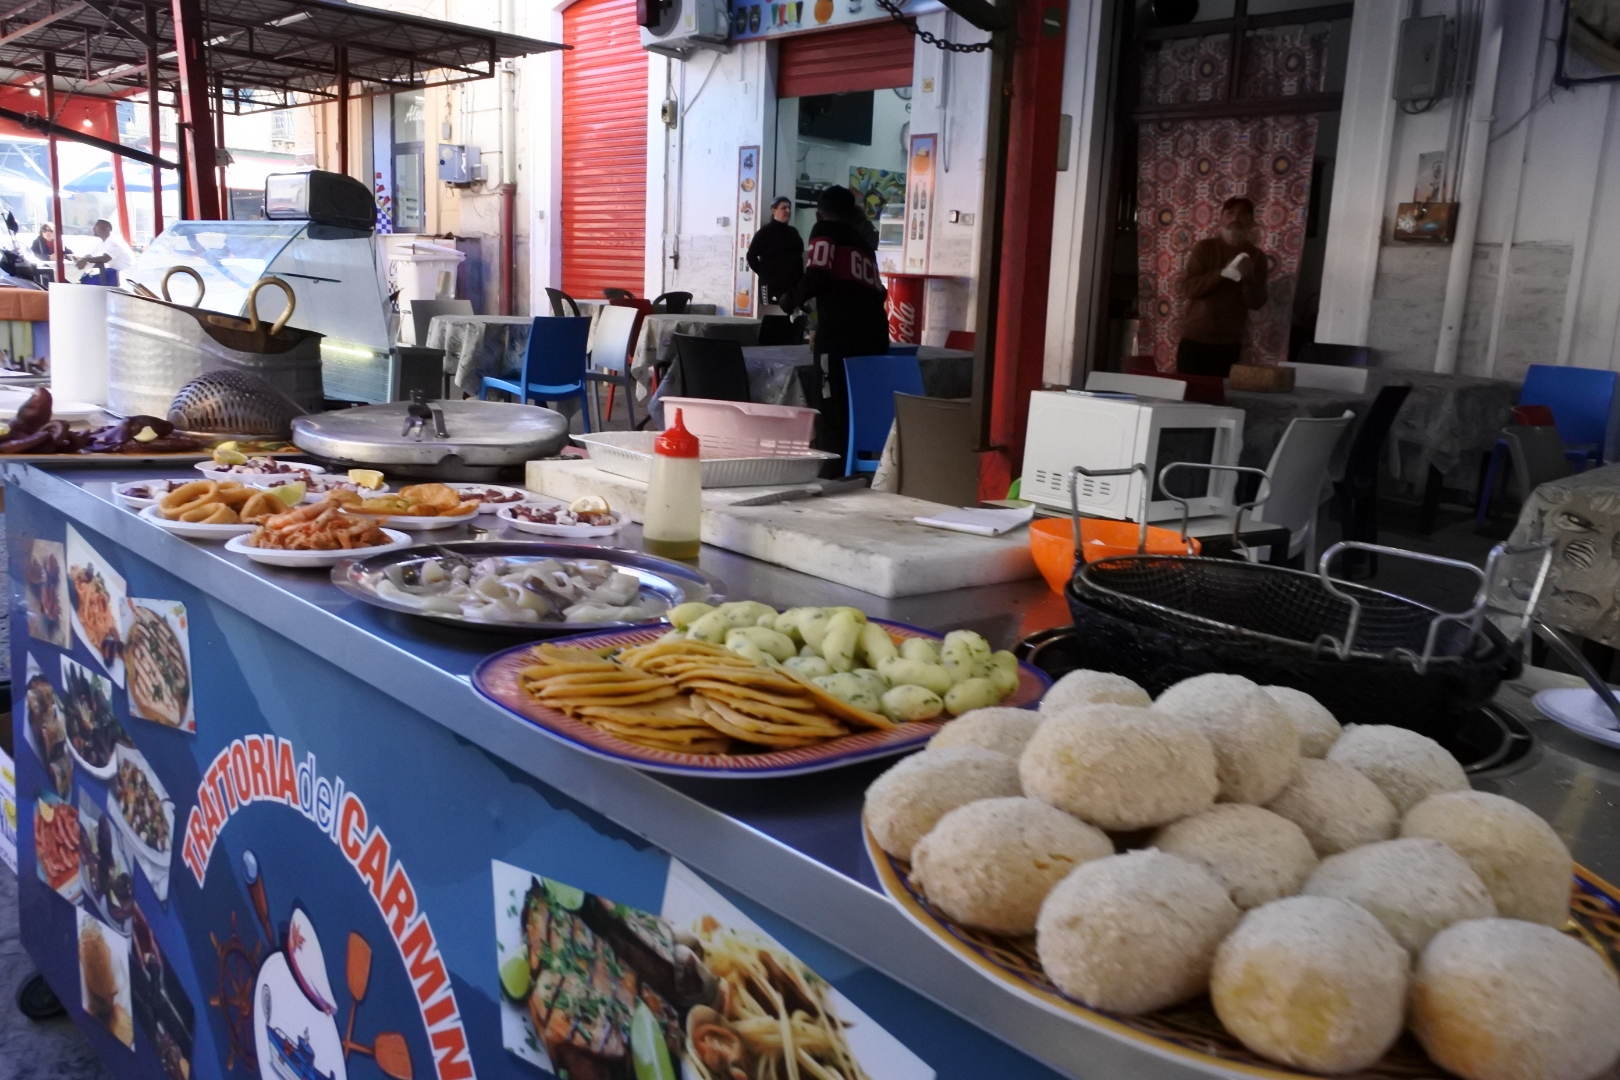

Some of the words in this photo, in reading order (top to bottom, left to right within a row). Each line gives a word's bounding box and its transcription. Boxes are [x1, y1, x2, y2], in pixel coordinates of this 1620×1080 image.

[181, 733, 300, 889] TRATTORIA
[298, 751, 345, 845] del
[339, 791, 477, 1080] CARMIN
